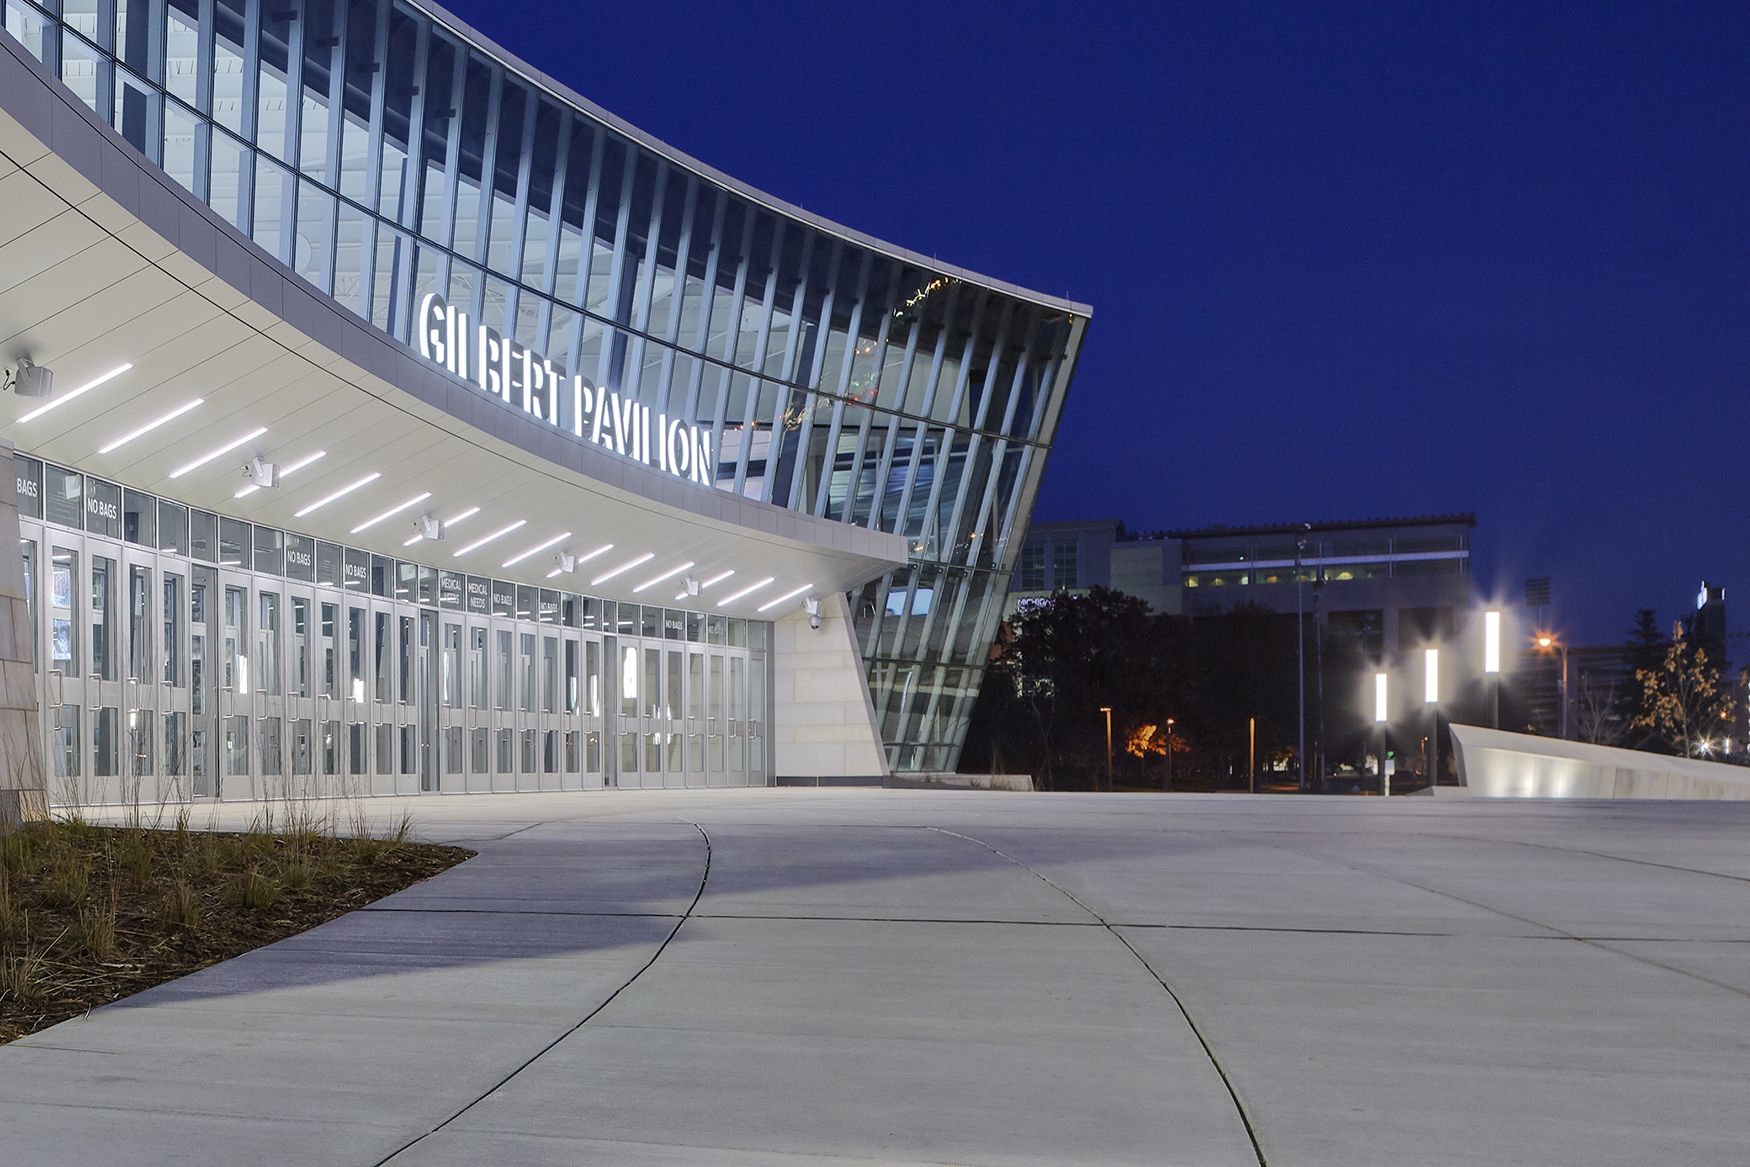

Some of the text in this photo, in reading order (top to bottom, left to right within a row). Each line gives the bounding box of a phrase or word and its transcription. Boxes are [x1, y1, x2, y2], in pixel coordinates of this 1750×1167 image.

[419, 293, 718, 487] GILBERT PAVILION
[16, 478, 37, 497] BAGS
[87, 497, 98, 514] NO
[99, 501, 117, 520] BAGS
[287, 550, 311, 566] NO BAGS
[345, 563, 353, 576] NO
[354, 566, 366, 578] BAGS
[441, 577, 461, 591] MEDICAL
[468, 582, 488, 595] MEDICAL
[471, 596, 486, 608] NEEDS
[493, 594, 500, 603] NO
[500, 595, 512, 605] BAGS
[665, 619, 683, 630] NO BAGS
